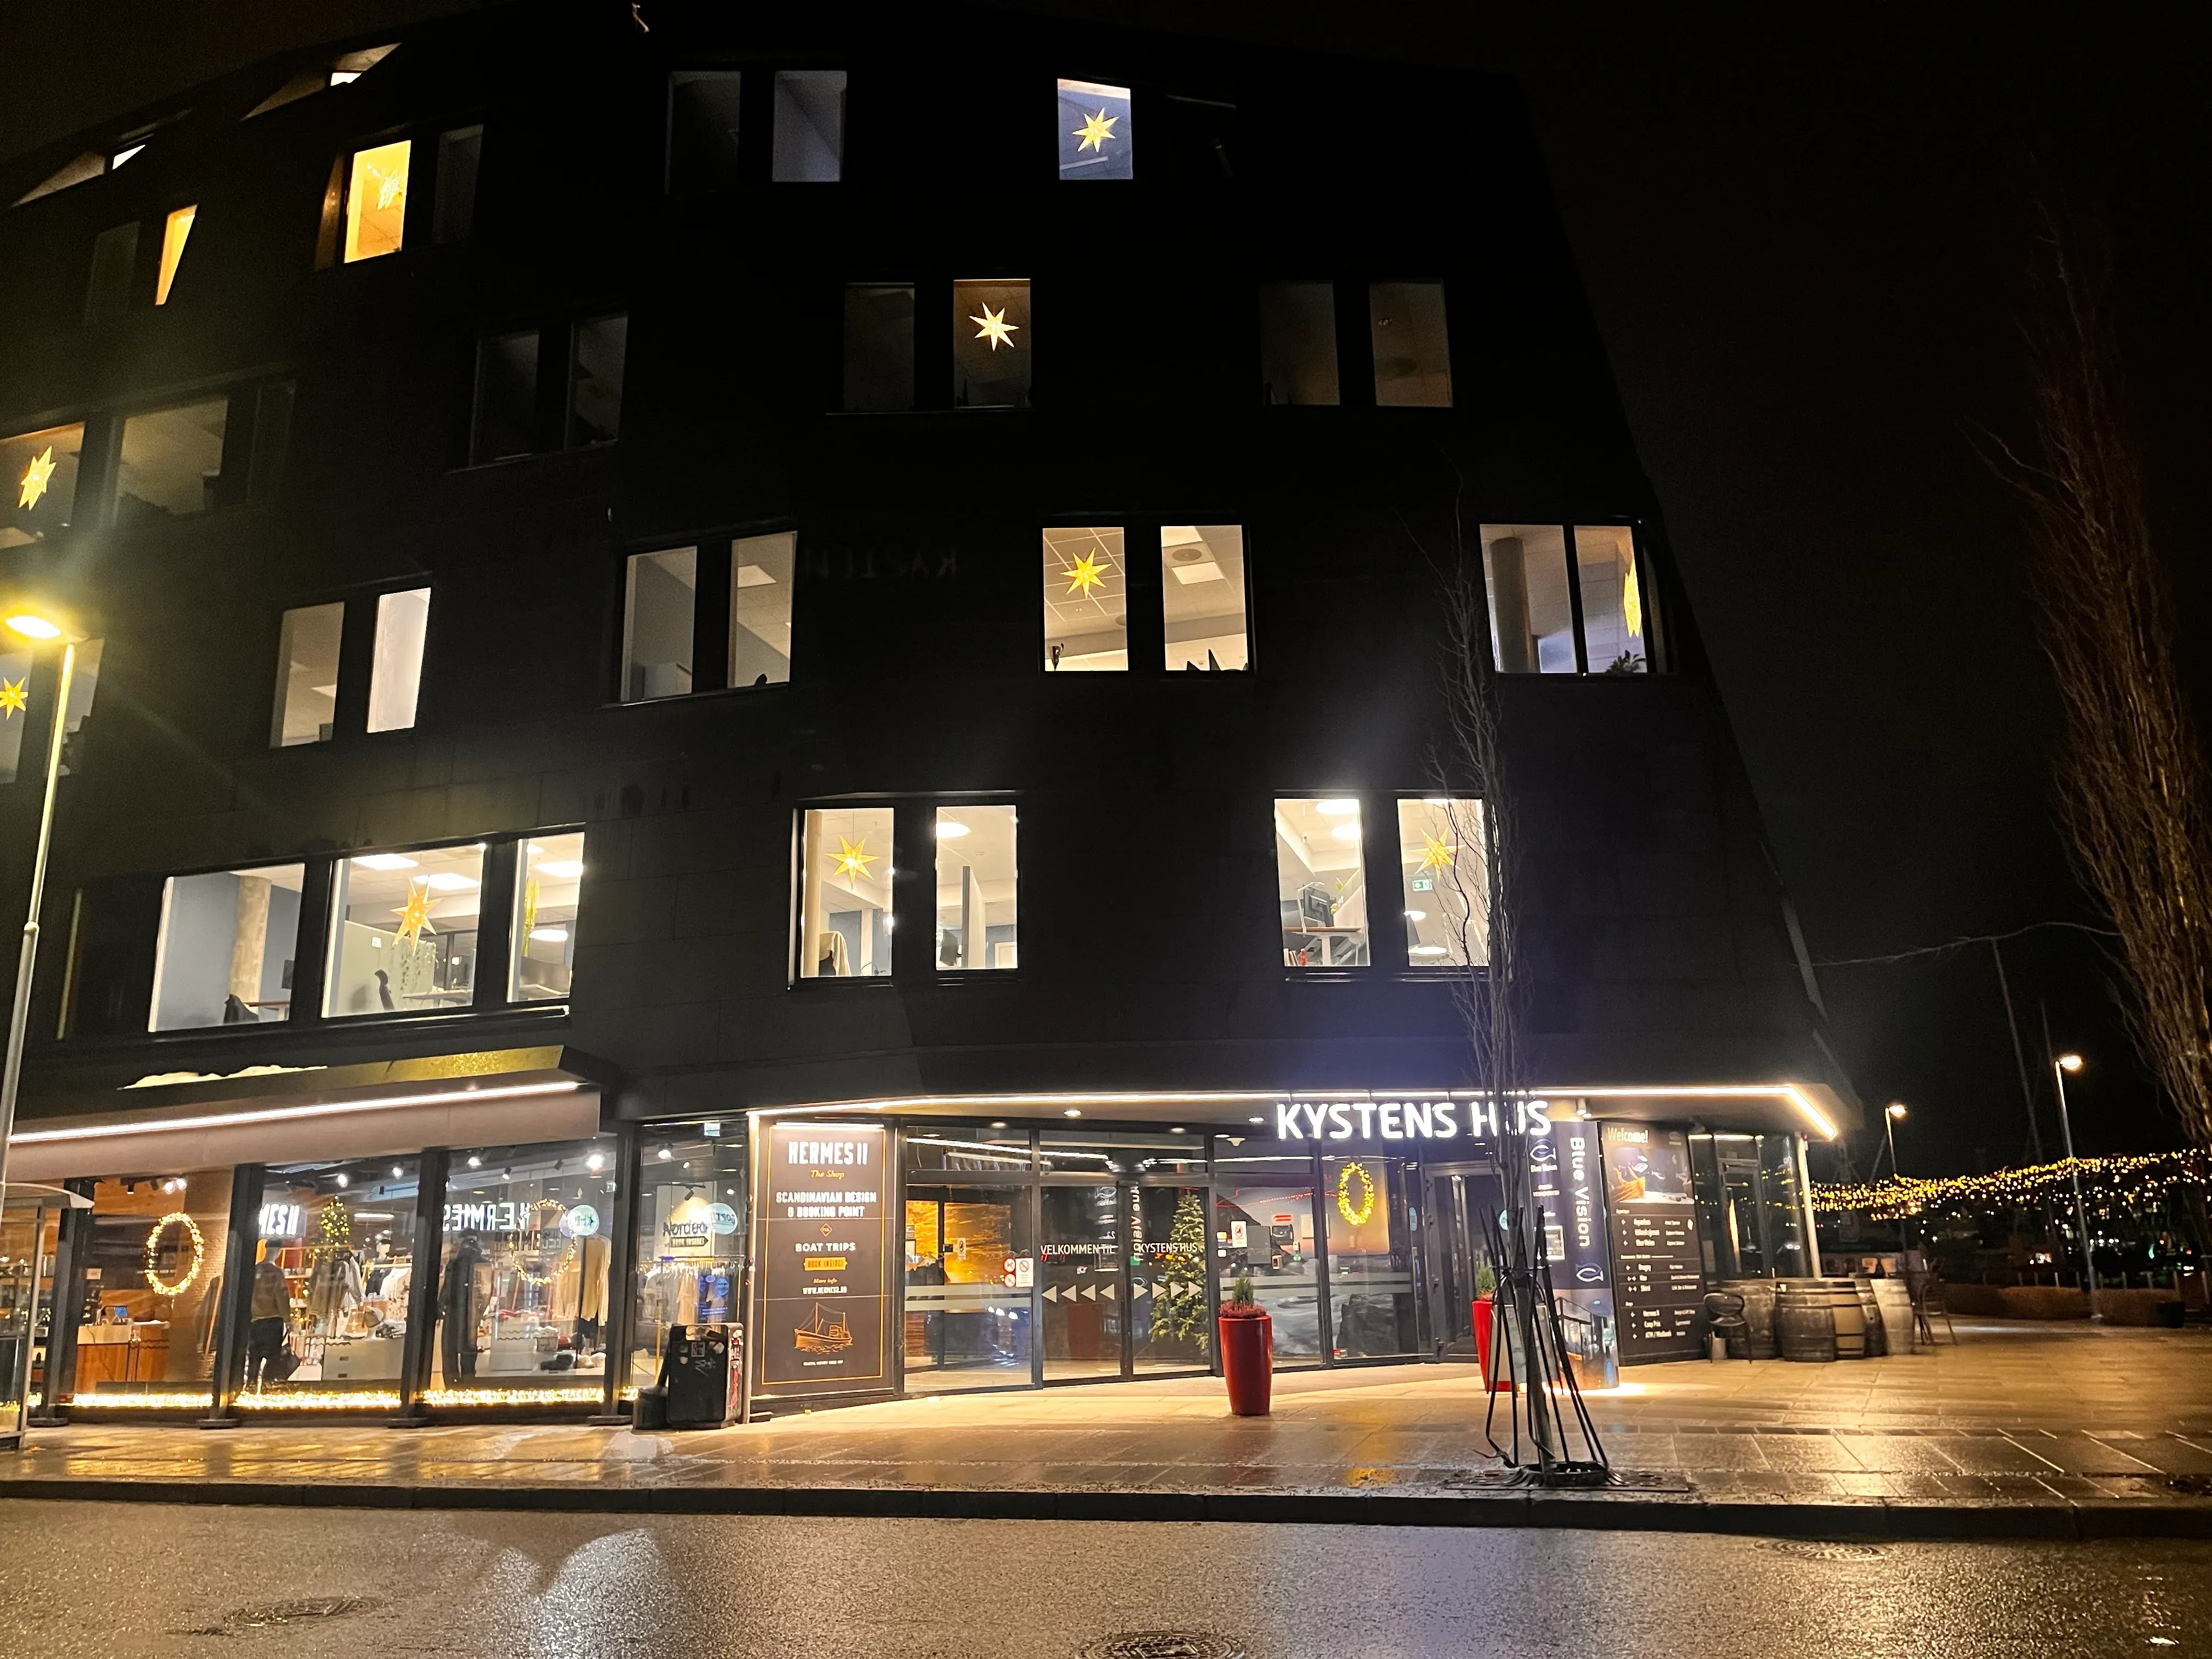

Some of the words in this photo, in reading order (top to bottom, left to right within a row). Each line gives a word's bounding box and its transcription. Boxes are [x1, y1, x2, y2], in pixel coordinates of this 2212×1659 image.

[1277, 1101, 1457, 1140] KYSTENS
[1469, 1100, 1553, 1138] HUS
[1607, 1127, 1649, 1143] Welcome!
[788, 1141, 854, 1165] HERMES
[856, 1142, 868, 1165] II
[1570, 1137, 1586, 1181] Blue
[811, 1170, 825, 1178] The
[826, 1170, 845, 1180] Shop
[776, 1191, 843, 1204] SCANDINAVIAN
[844, 1191, 877, 1203] DESIGN
[797, 1206, 836, 1218] BOOKING
[838, 1205, 865, 1218] POINT
[1575, 1186, 1592, 1248] Vision
[795, 1243, 823, 1252] BOAT
[826, 1242, 856, 1252] TRIPS
[1040, 1244, 1099, 1255] VELKOMMEN
[1138, 1242, 1178, 1254] KYSTENS
[1180, 1242, 1198, 1252] HUS
